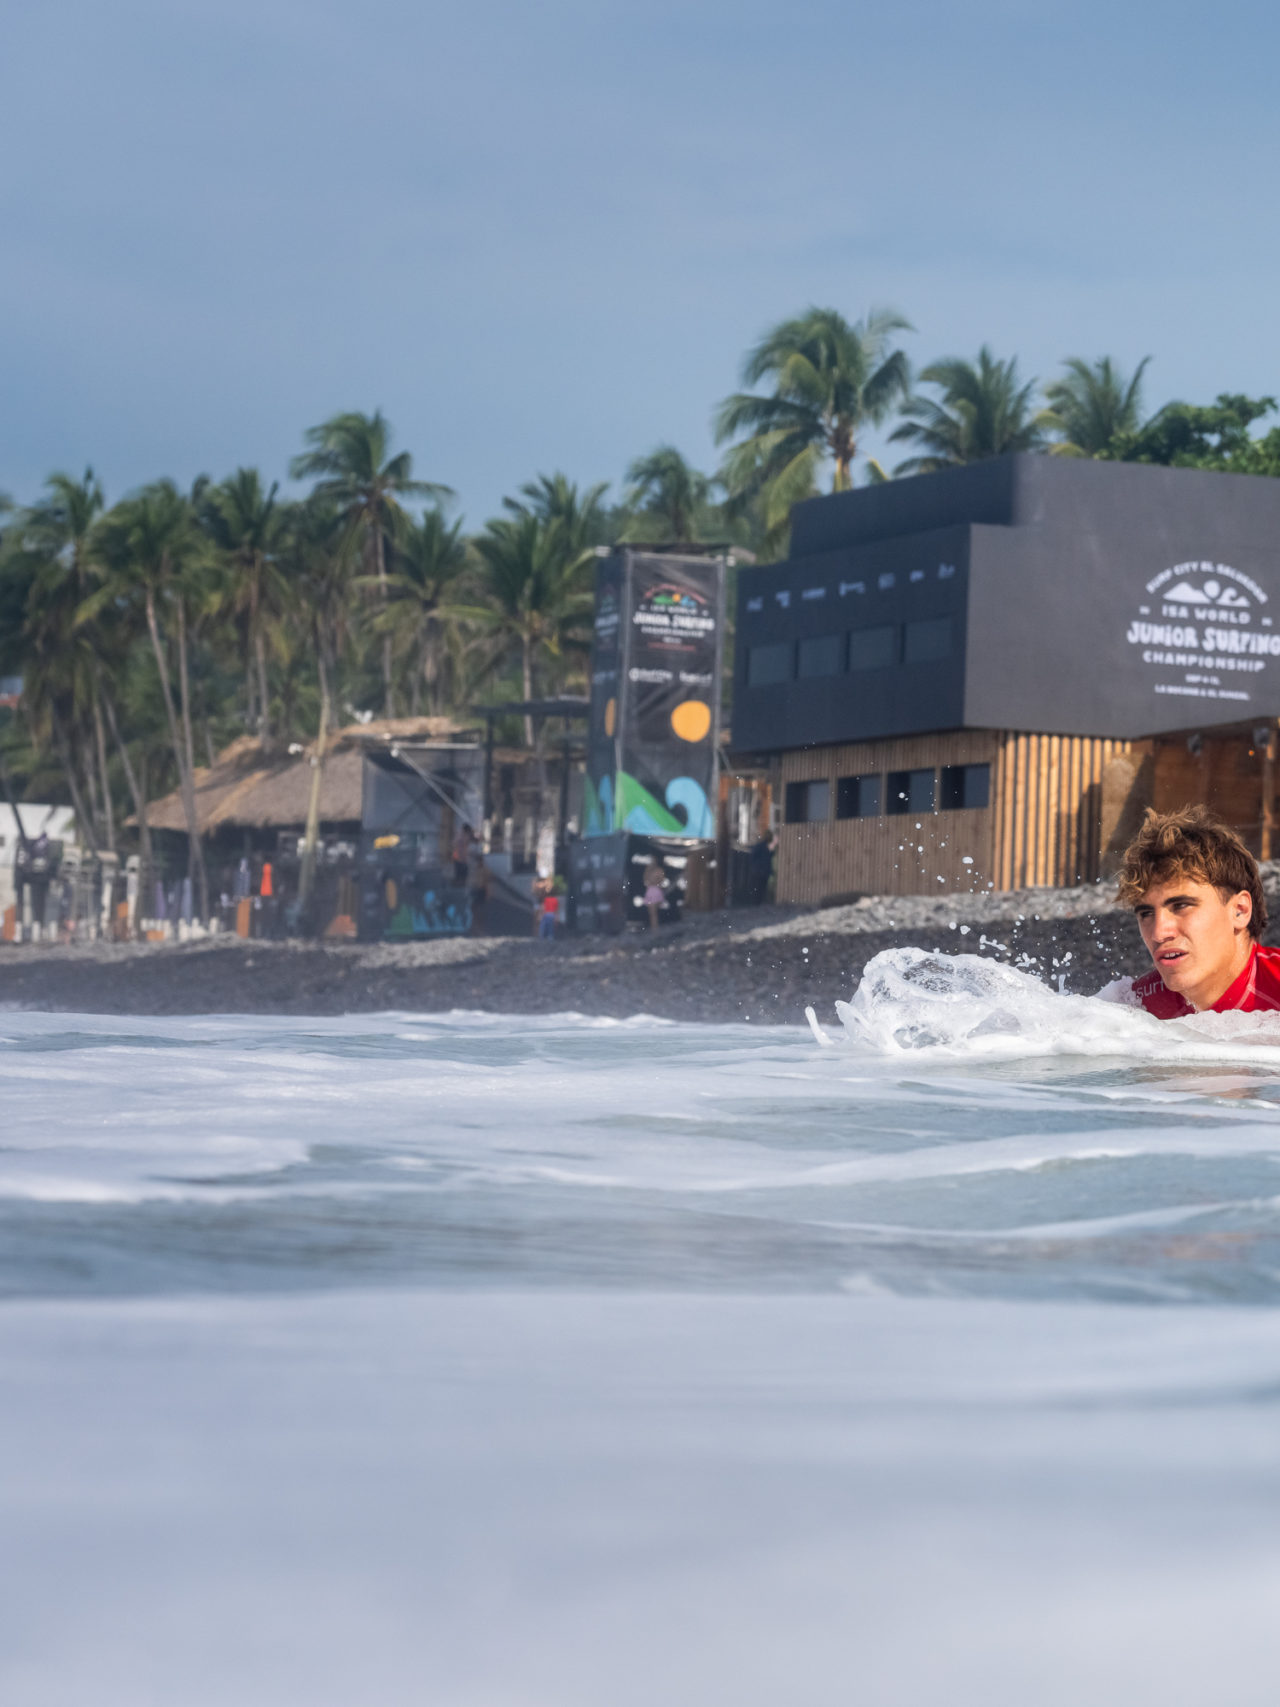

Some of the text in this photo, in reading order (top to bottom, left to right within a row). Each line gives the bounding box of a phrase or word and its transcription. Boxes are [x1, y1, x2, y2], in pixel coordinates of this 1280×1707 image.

[1162, 604, 1251, 624] ISA WORLD
[1126, 620, 1199, 648] JUNIOR
[1142, 650, 1266, 672] CHAMPIONSHIP
[1136, 979, 1164, 999] surf
